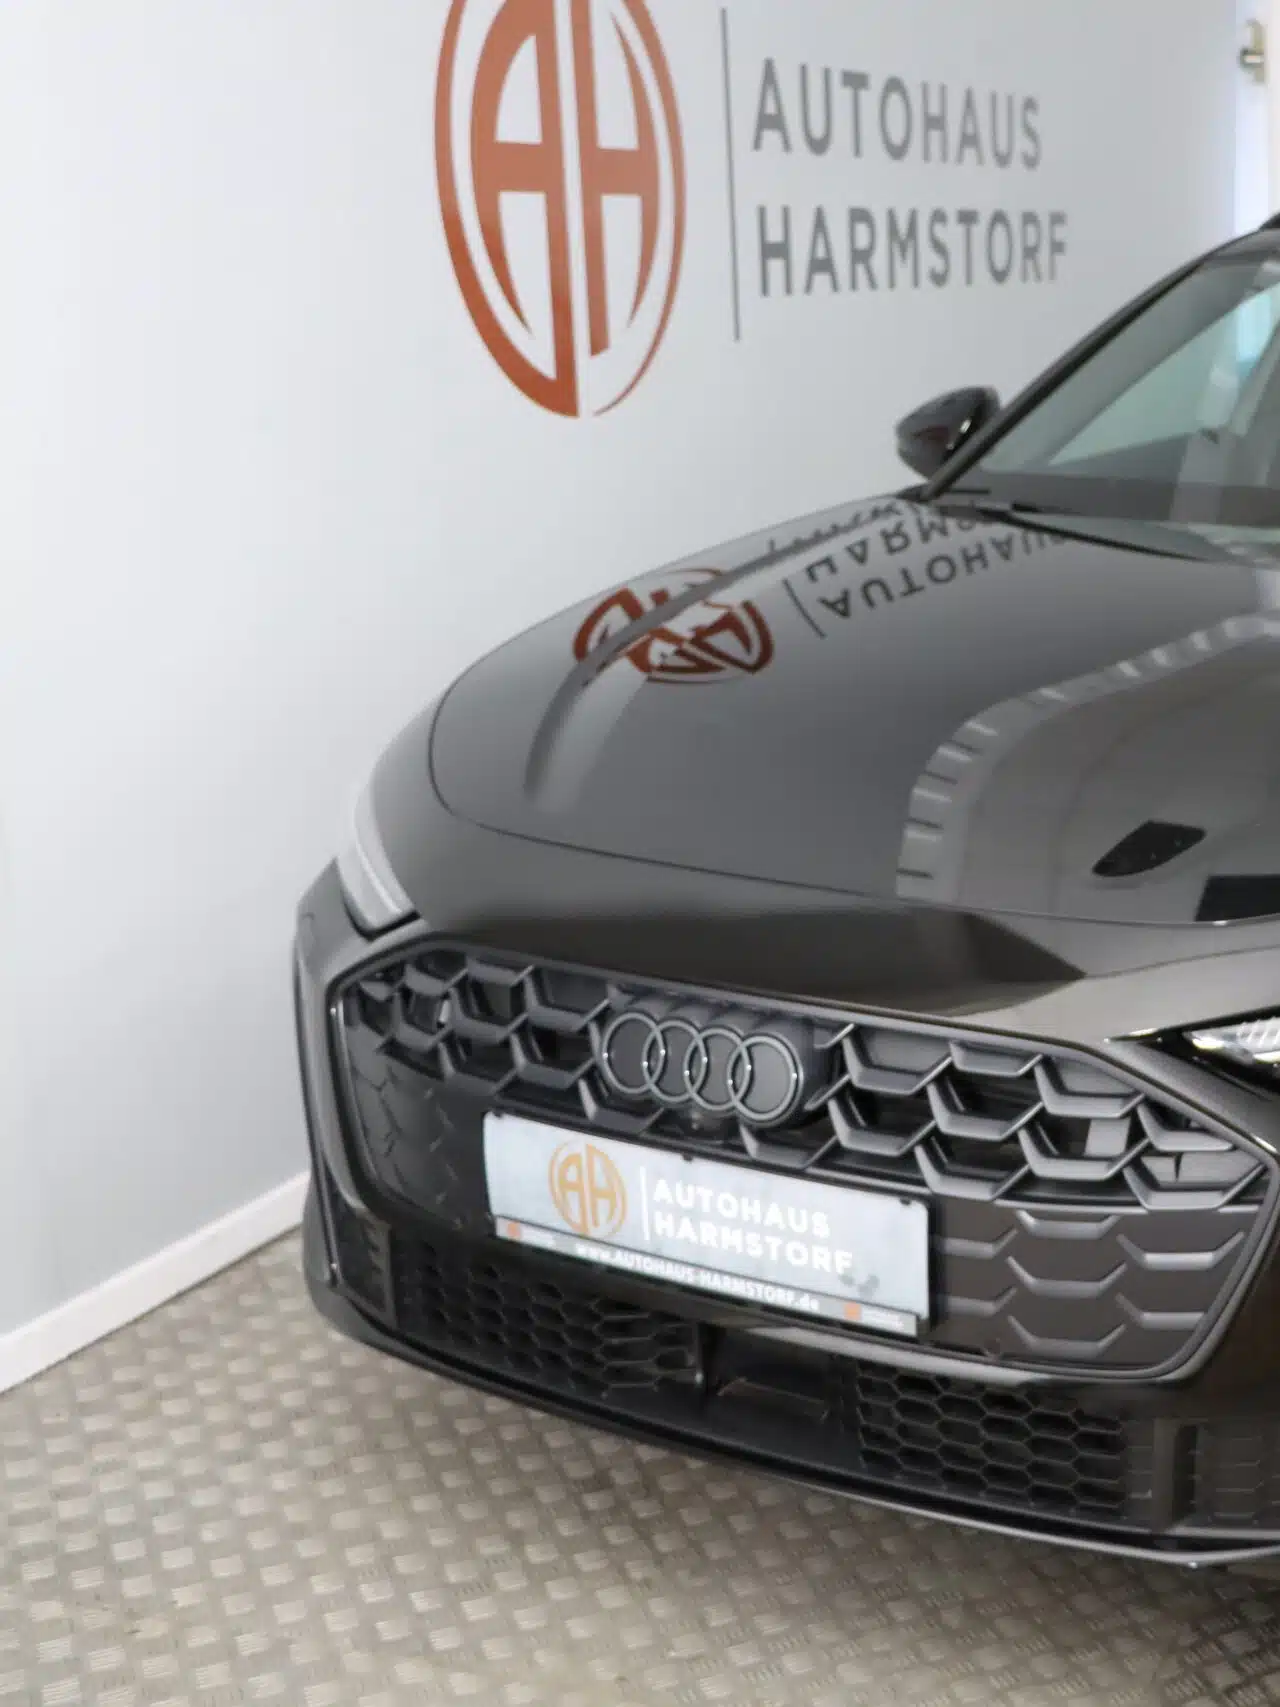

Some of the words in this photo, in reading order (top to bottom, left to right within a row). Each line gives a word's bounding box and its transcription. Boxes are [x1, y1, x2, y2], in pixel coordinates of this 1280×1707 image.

[753, 57, 1042, 170] AUTOHAUS
[757, 204, 1068, 298] HARMSTORF
[653, 1179, 831, 1239] AUTOHAUS
[654, 1211, 853, 1275] HARMSTORF
